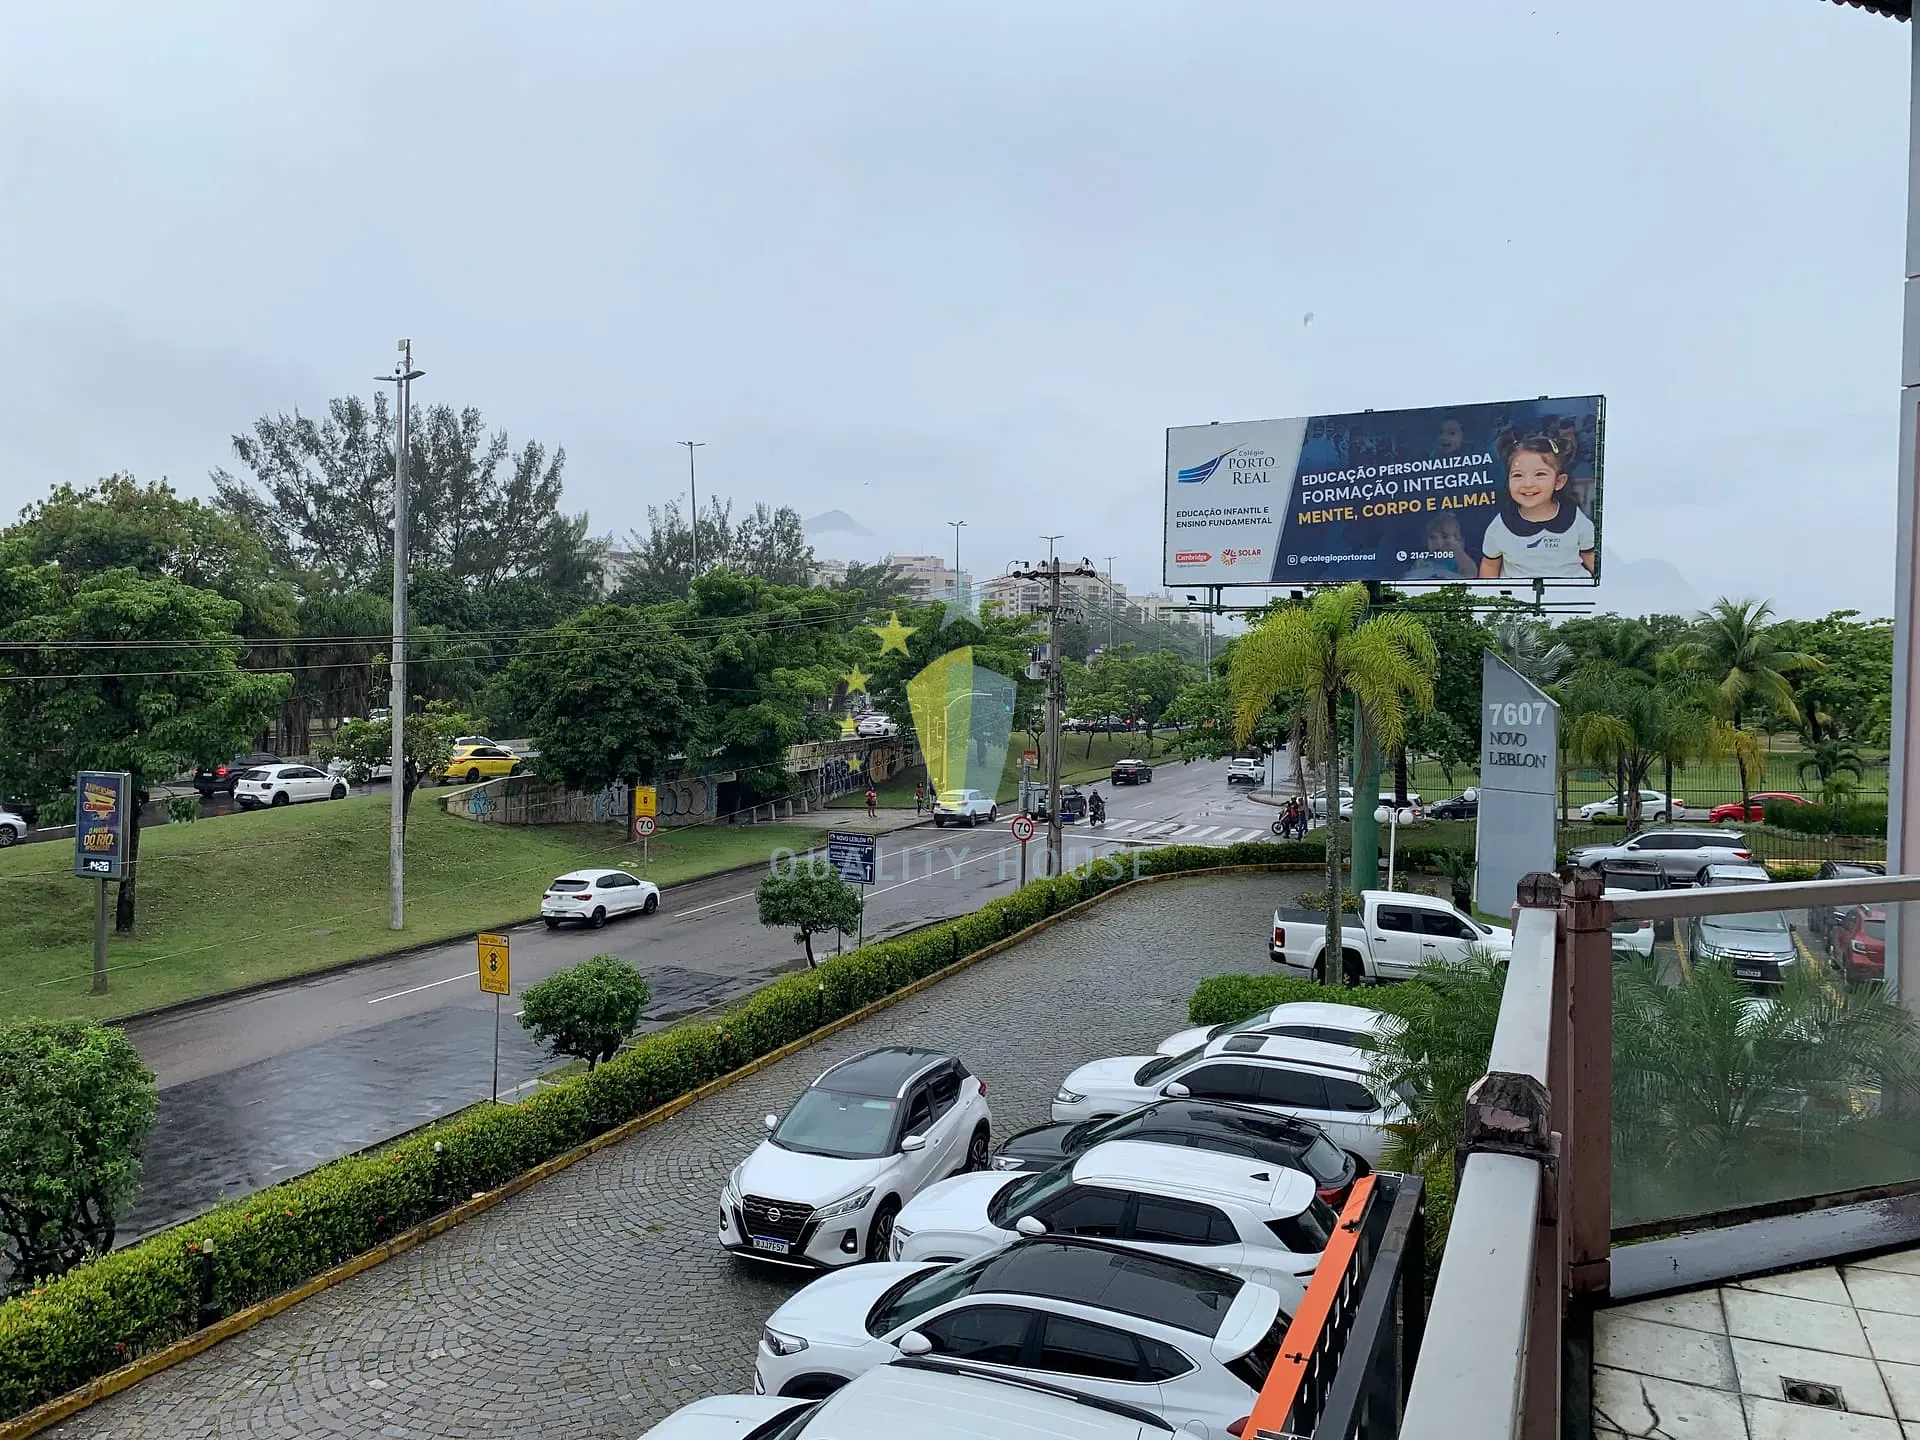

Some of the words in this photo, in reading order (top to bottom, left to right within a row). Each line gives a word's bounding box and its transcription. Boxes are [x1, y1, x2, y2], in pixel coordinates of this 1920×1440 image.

[1228, 456, 1275, 469] PORTO
[1302, 465, 1377, 486] EDUCAÇÃO
[1379, 452, 1493, 477] PERSONALIZADA
[1233, 470, 1270, 485] REAL
[1302, 479, 1398, 505] FORMAÇÃO
[1403, 470, 1494, 493] INTEGRAL
[1176, 508, 1222, 519] EDUCAÇÃO
[1223, 506, 1262, 516] INFANTIL
[1263, 506, 1269, 514] E
[1298, 506, 1358, 525] MENTE,
[1362, 499, 1422, 518] CORPO
[1426, 497, 1437, 511] E
[1440, 490, 1496, 510] ALMA!
[1176, 520, 1207, 528] ENSINO
[1208, 517, 1273, 528] FUNDAMENTAL
[1238, 549, 1262, 557] SOLAR
[1300, 553, 1376, 564] @colegioportoreal
[1410, 551, 1455, 560] 2147-1006
[1488, 702, 1547, 726] 7607
[1489, 731, 1528, 747] NOVO
[1488, 752, 1548, 769] LEBLON
[638, 820, 653, 830] 70
[1016, 822, 1030, 833] 70
